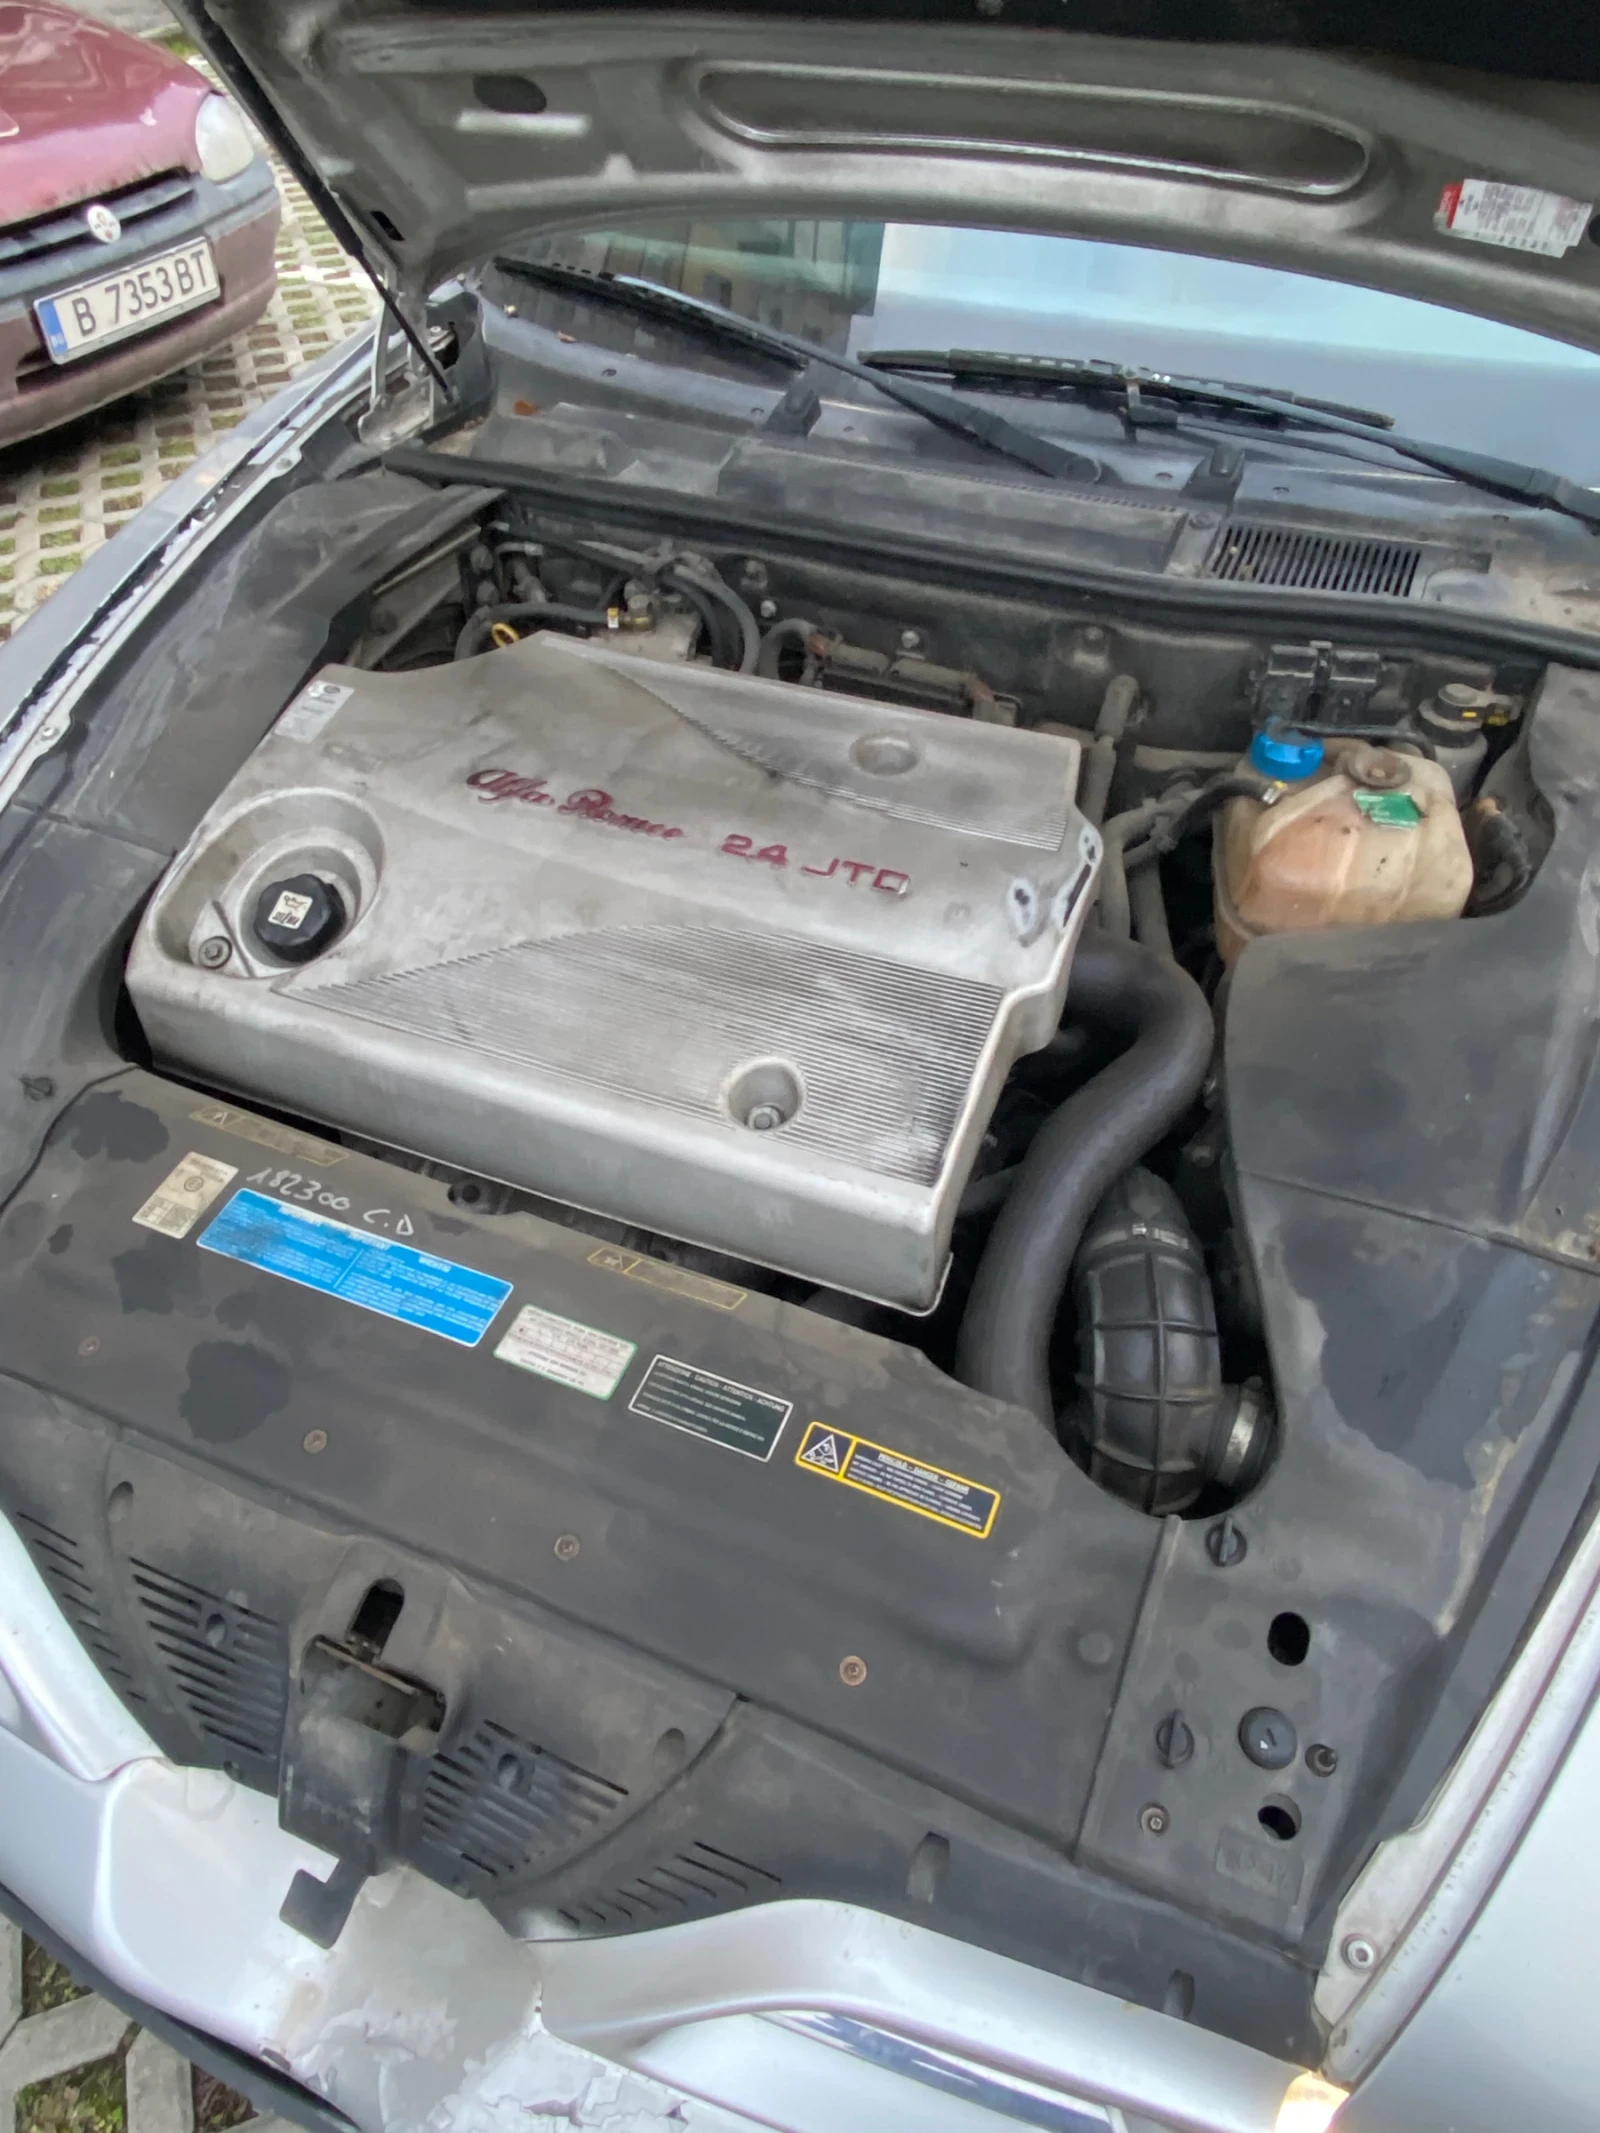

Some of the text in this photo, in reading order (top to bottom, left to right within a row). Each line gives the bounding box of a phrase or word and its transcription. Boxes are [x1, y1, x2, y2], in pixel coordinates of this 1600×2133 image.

[72, 250, 207, 336] B 7353 BT
[466, 768, 684, 840] Alfa Romeo
[246, 1167, 350, 1210] 182300
